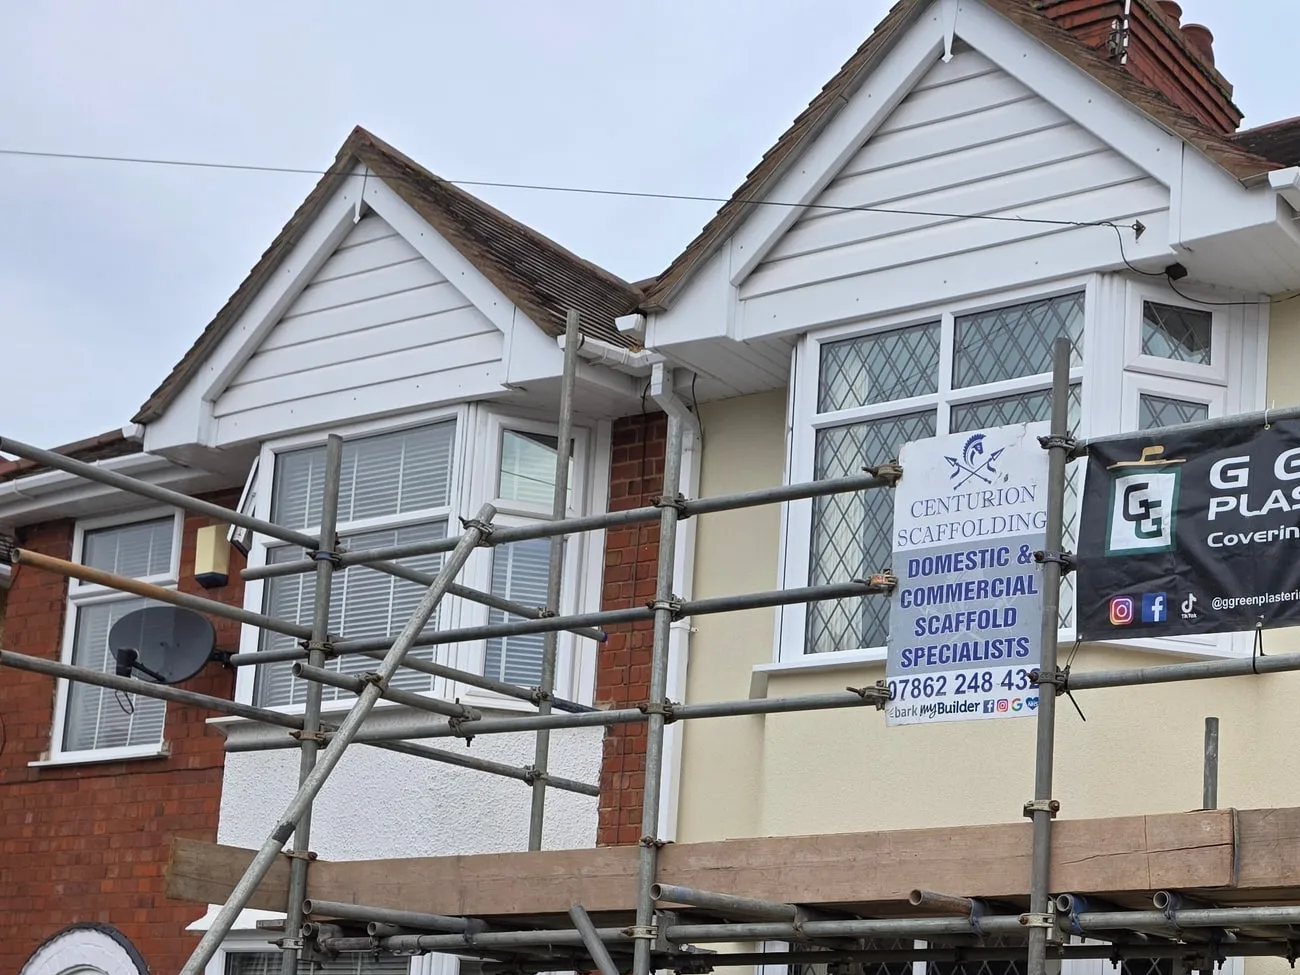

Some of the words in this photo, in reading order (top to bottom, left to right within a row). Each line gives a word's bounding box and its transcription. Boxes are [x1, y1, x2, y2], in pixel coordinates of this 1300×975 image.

[1209, 455, 1250, 489] G
[910, 485, 1037, 518] CENTURION
[897, 511, 1047, 547] SCAFFOLDING
[908, 547, 1010, 579] DOMESTIC
[1016, 544, 1032, 565] &
[900, 575, 1038, 609] COMMERCIAL
[914, 607, 1018, 637] SCAFFOLD
[900, 637, 1030, 668] SPECIALISTS
[887, 675, 947, 701] 07862
[954, 671, 993, 695] 248
[895, 705, 917, 718] bark
[920, 700, 980, 719] myBuilder
